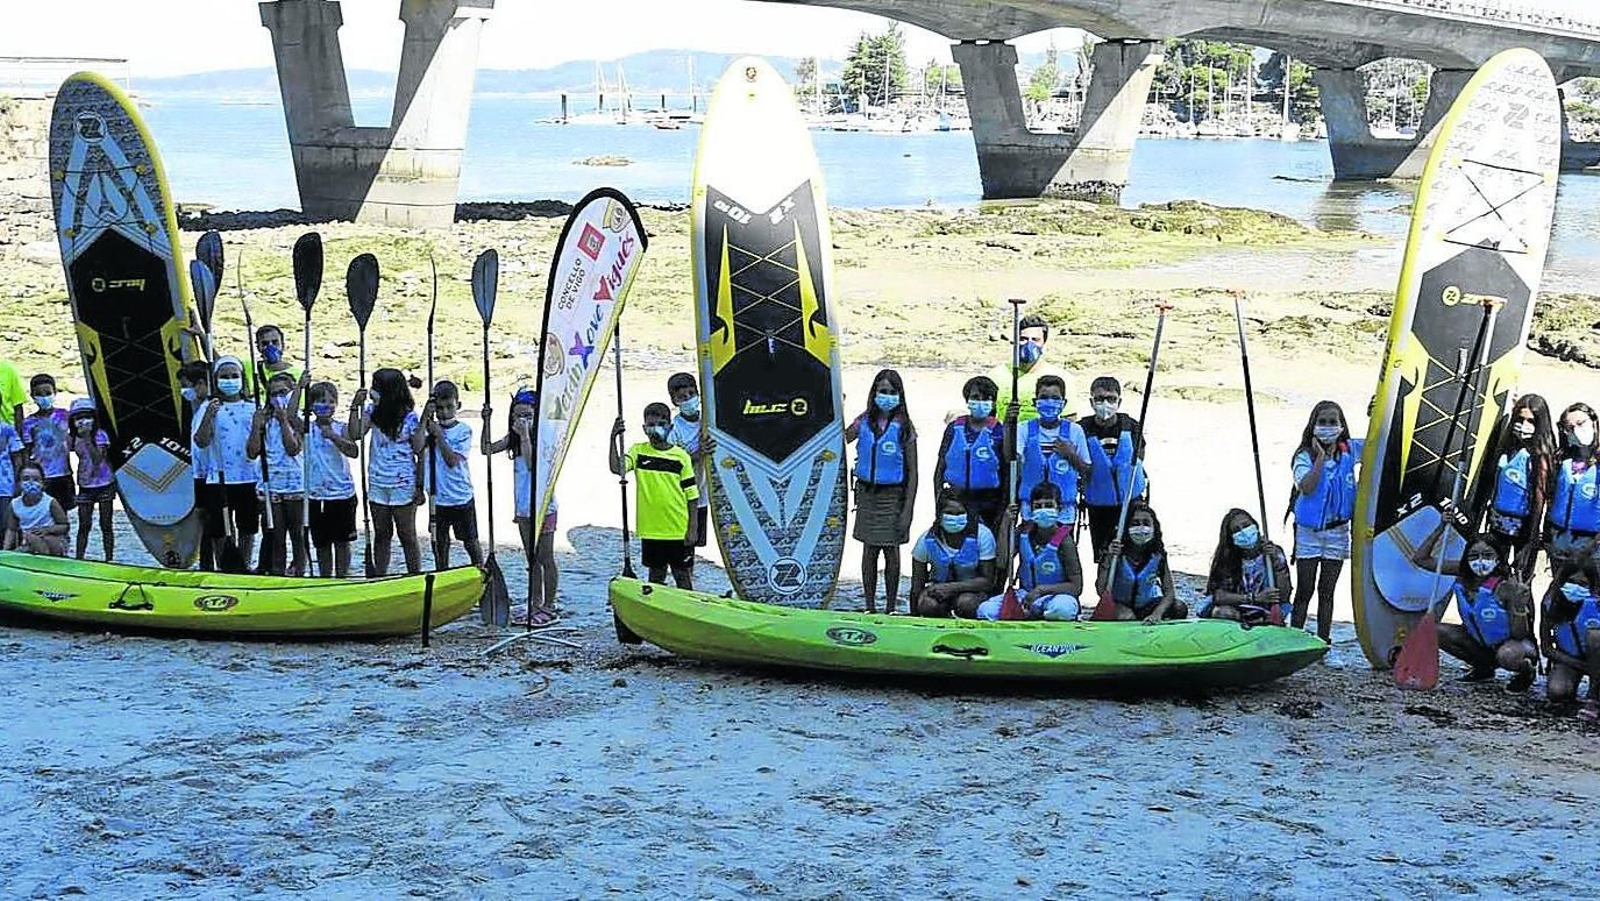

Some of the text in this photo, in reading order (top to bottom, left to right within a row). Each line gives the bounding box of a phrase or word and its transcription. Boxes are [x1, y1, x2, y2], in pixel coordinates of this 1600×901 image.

[558, 258, 582, 310] CONCELLO
[565, 269, 586, 310] DE VIGO
[593, 231, 634, 301] Vigués
